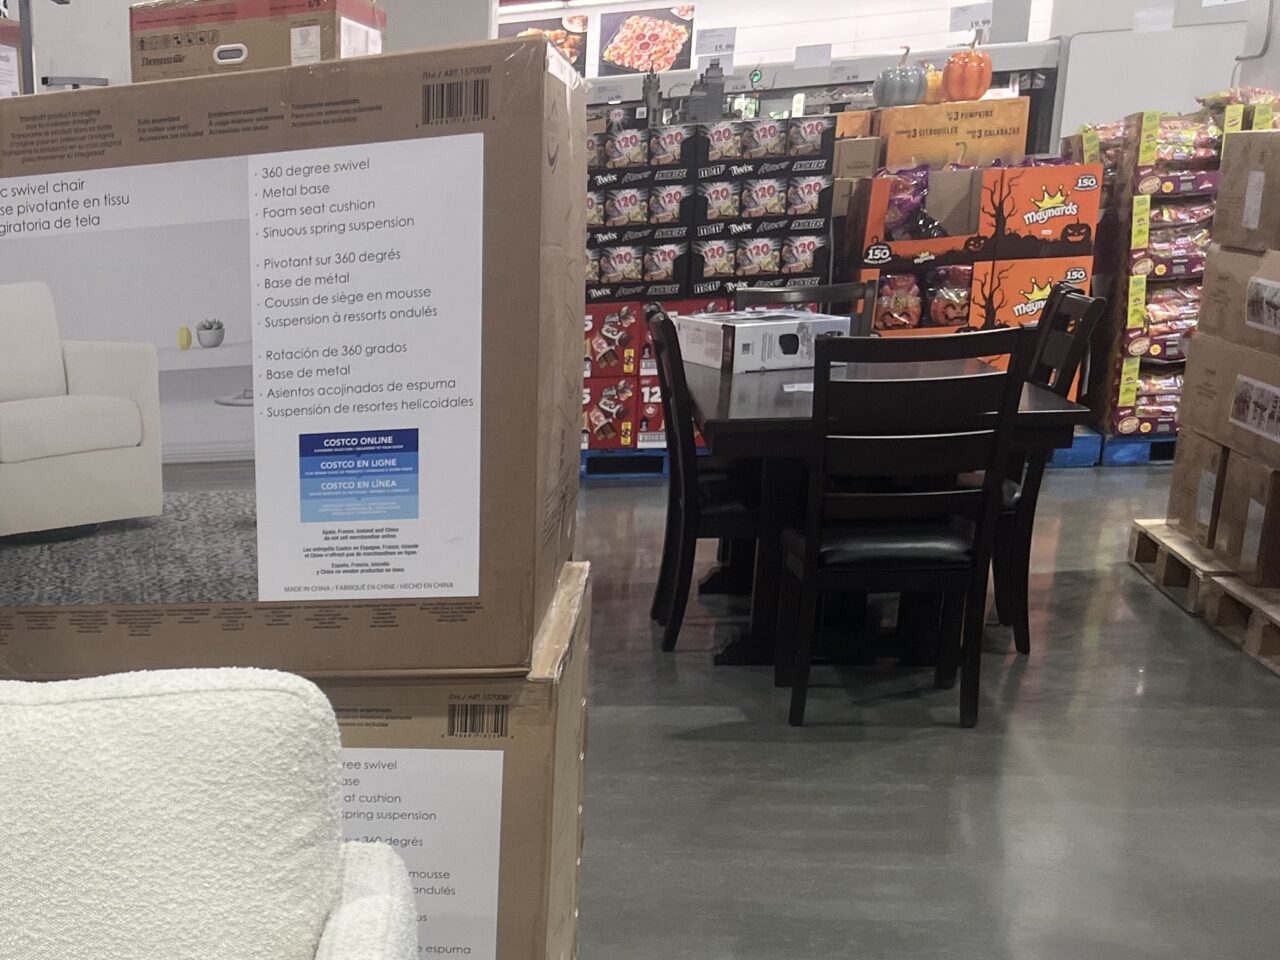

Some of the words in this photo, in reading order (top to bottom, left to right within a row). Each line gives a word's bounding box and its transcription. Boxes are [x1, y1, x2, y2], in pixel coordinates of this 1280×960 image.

[710, 128, 732, 143] 120
[756, 125, 777, 138] 120
[802, 122, 824, 135] 120
[619, 135, 638, 149] 120
[662, 132, 683, 145] 120
[261, 167, 283, 179] 360
[285, 163, 331, 178] degree
[333, 158, 371, 173] swivel
[11, 182, 49, 196] swivel
[52, 179, 85, 193] chair
[800, 182, 822, 195] 120
[1077, 178, 1097, 188] 150
[262, 185, 297, 199] Metal
[300, 182, 330, 196] base
[662, 191, 682, 204] 120
[708, 188, 729, 201] 120
[754, 185, 775, 198] 120
[17, 200, 80, 218] pivotante
[83, 197, 101, 208] en
[104, 194, 130, 207] tissu
[618, 195, 637, 208] 120
[263, 205, 297, 219] Foam
[300, 203, 326, 217] seat
[329, 199, 376, 213] cushion
[1023, 202, 1079, 226] Maynards
[55, 217, 72, 229] de
[76, 215, 101, 228] tela
[263, 226, 307, 239] Sinuous
[310, 222, 346, 237] spring
[348, 216, 415, 234] suspension
[704, 246, 725, 260] 120
[748, 243, 770, 257] 120
[794, 241, 816, 255] 120
[868, 249, 890, 260] 150
[264, 256, 312, 270] Pivotant
[315, 256, 332, 267] sur
[335, 252, 356, 265] 360
[358, 248, 401, 265] degrés
[264, 278, 292, 290] Base
[295, 275, 312, 288] de
[315, 272, 350, 286] métal
[1066, 270, 1086, 281] 150
[264, 295, 310, 309] Coussin
[312, 294, 329, 306] de
[331, 289, 364, 305] siège
[367, 291, 383, 302] en
[385, 287, 432, 301] mousse
[264, 313, 330, 331] Suspension
[332, 311, 341, 324] à
[343, 308, 387, 323] ressorts
[390, 305, 438, 320] ondulés
[265, 347, 319, 362] Rotación
[322, 345, 339, 358] de
[341, 344, 363, 357] 360
[365, 342, 408, 358] grados
[266, 368, 294, 381] Base
[296, 367, 314, 379] de
[316, 364, 351, 377] metal
[266, 386, 315, 400] Asientos
[317, 382, 384, 399] acojinados
[387, 380, 404, 393] de
[406, 378, 456, 395] espuma
[266, 403, 331, 419] Suspensión
[333, 402, 350, 415] de
[352, 400, 398, 414] resortes
[401, 396, 474, 412] helicoidales
[323, 438, 358, 447] COSTCO
[360, 436, 393, 445] ONLINE
[320, 461, 354, 470] COSTCO
[371, 459, 397, 467] LIGNE
[321, 482, 355, 490] COSTCO
[357, 481, 369, 489] EN
[364, 760, 397, 770] swivel
[359, 794, 402, 803] cushion
[376, 811, 437, 821] suspension
[408, 869, 450, 880] mousse
[425, 944, 471, 955] espuma
